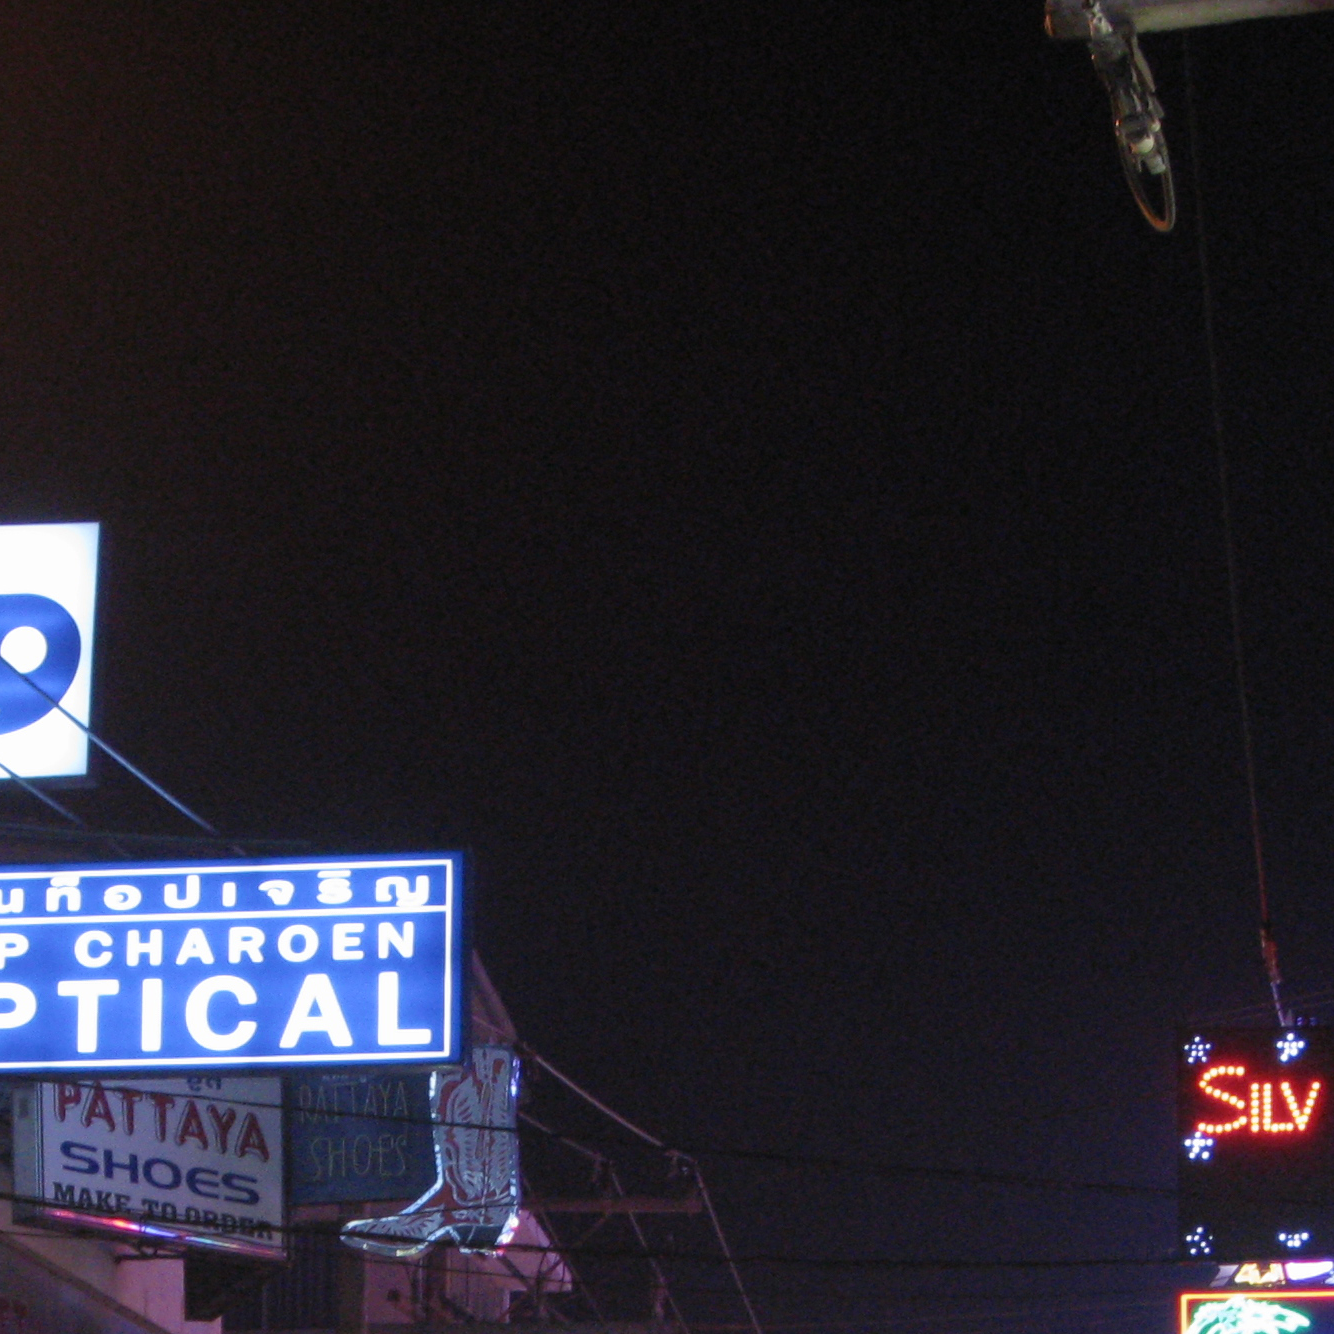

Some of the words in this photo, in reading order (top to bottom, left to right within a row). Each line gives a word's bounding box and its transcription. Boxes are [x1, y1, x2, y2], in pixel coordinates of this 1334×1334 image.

[74, 921, 415, 968] CHAROEN
[53, 1080, 270, 1163] PATTAYA
[60, 1140, 260, 1205] SHOES
[52, 1182, 132, 1213] MAKE
[142, 1199, 178, 1221] TO
[185, 1207, 273, 1240] ORDER
